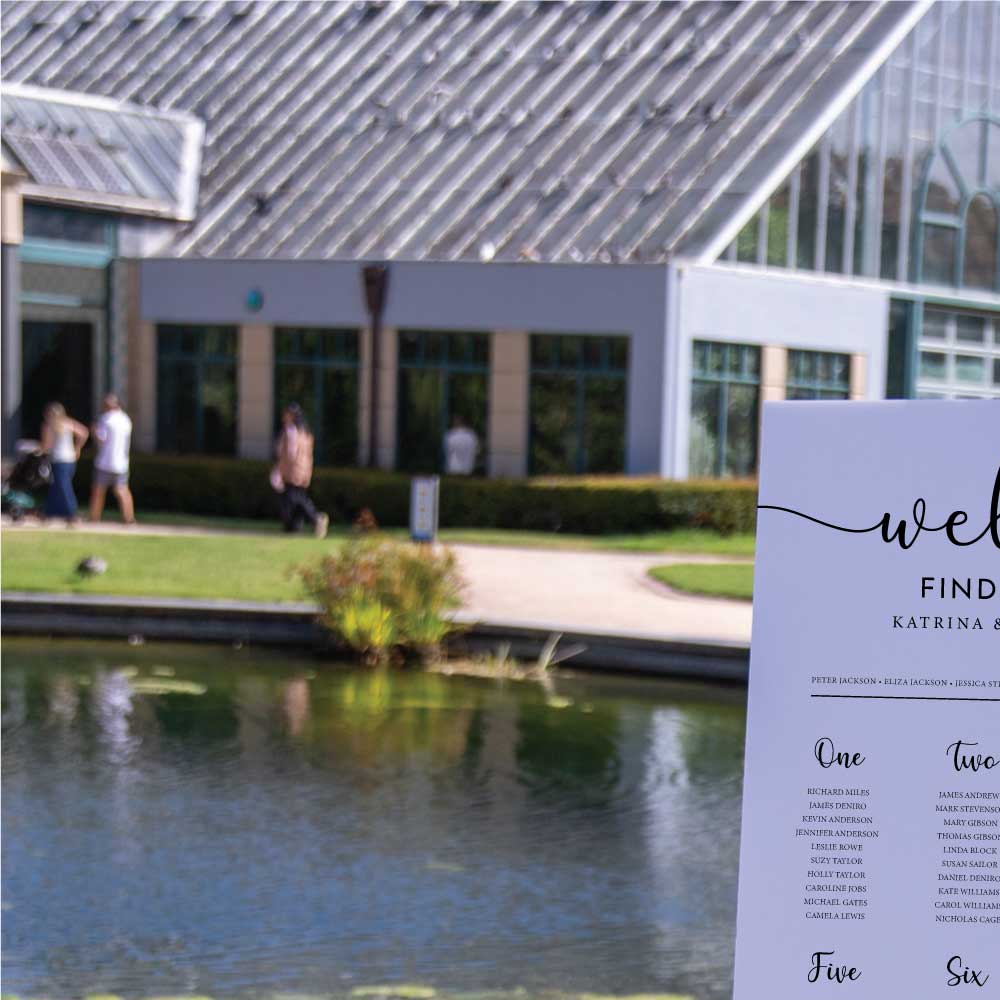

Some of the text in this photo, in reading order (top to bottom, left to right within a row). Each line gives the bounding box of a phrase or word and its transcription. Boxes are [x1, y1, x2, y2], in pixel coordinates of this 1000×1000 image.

[921, 576, 996, 601] FIND
[892, 615, 984, 630] KATRINA
[811, 675, 837, 684] PETER
[838, 676, 876, 685] JACKSON
[883, 677, 908, 686] ELIZA
[909, 677, 948, 687] JACKSON
[954, 678, 986, 687] JESSICA
[814, 737, 865, 768] One
[806, 787, 870, 796] RICHARD MILES
[938, 790, 964, 799] JAMES
[934, 804, 959, 812] MARK
[801, 814, 873, 824] KEVIN ANDERSON
[942, 818, 998, 827] MARY GIBSON
[936, 831, 972, 840] THOMAS
[810, 842, 863, 851] LESLIE ROWE
[942, 845, 997, 855] LINDA BLOCK
[809, 856, 863, 865] SUZY TAYLOR
[941, 859, 998, 868] SUSAN SAILOR
[937, 873, 968, 881] DANIEL
[804, 883, 867, 893] CAROLINE JOBS
[803, 897, 868, 906] MICHAEL GATES
[804, 911, 865, 920] CAMELA LEWIS
[934, 914, 1000, 924] NICHOLAS CAGE
[808, 951, 861, 983] Five
[947, 956, 989, 987] Six
